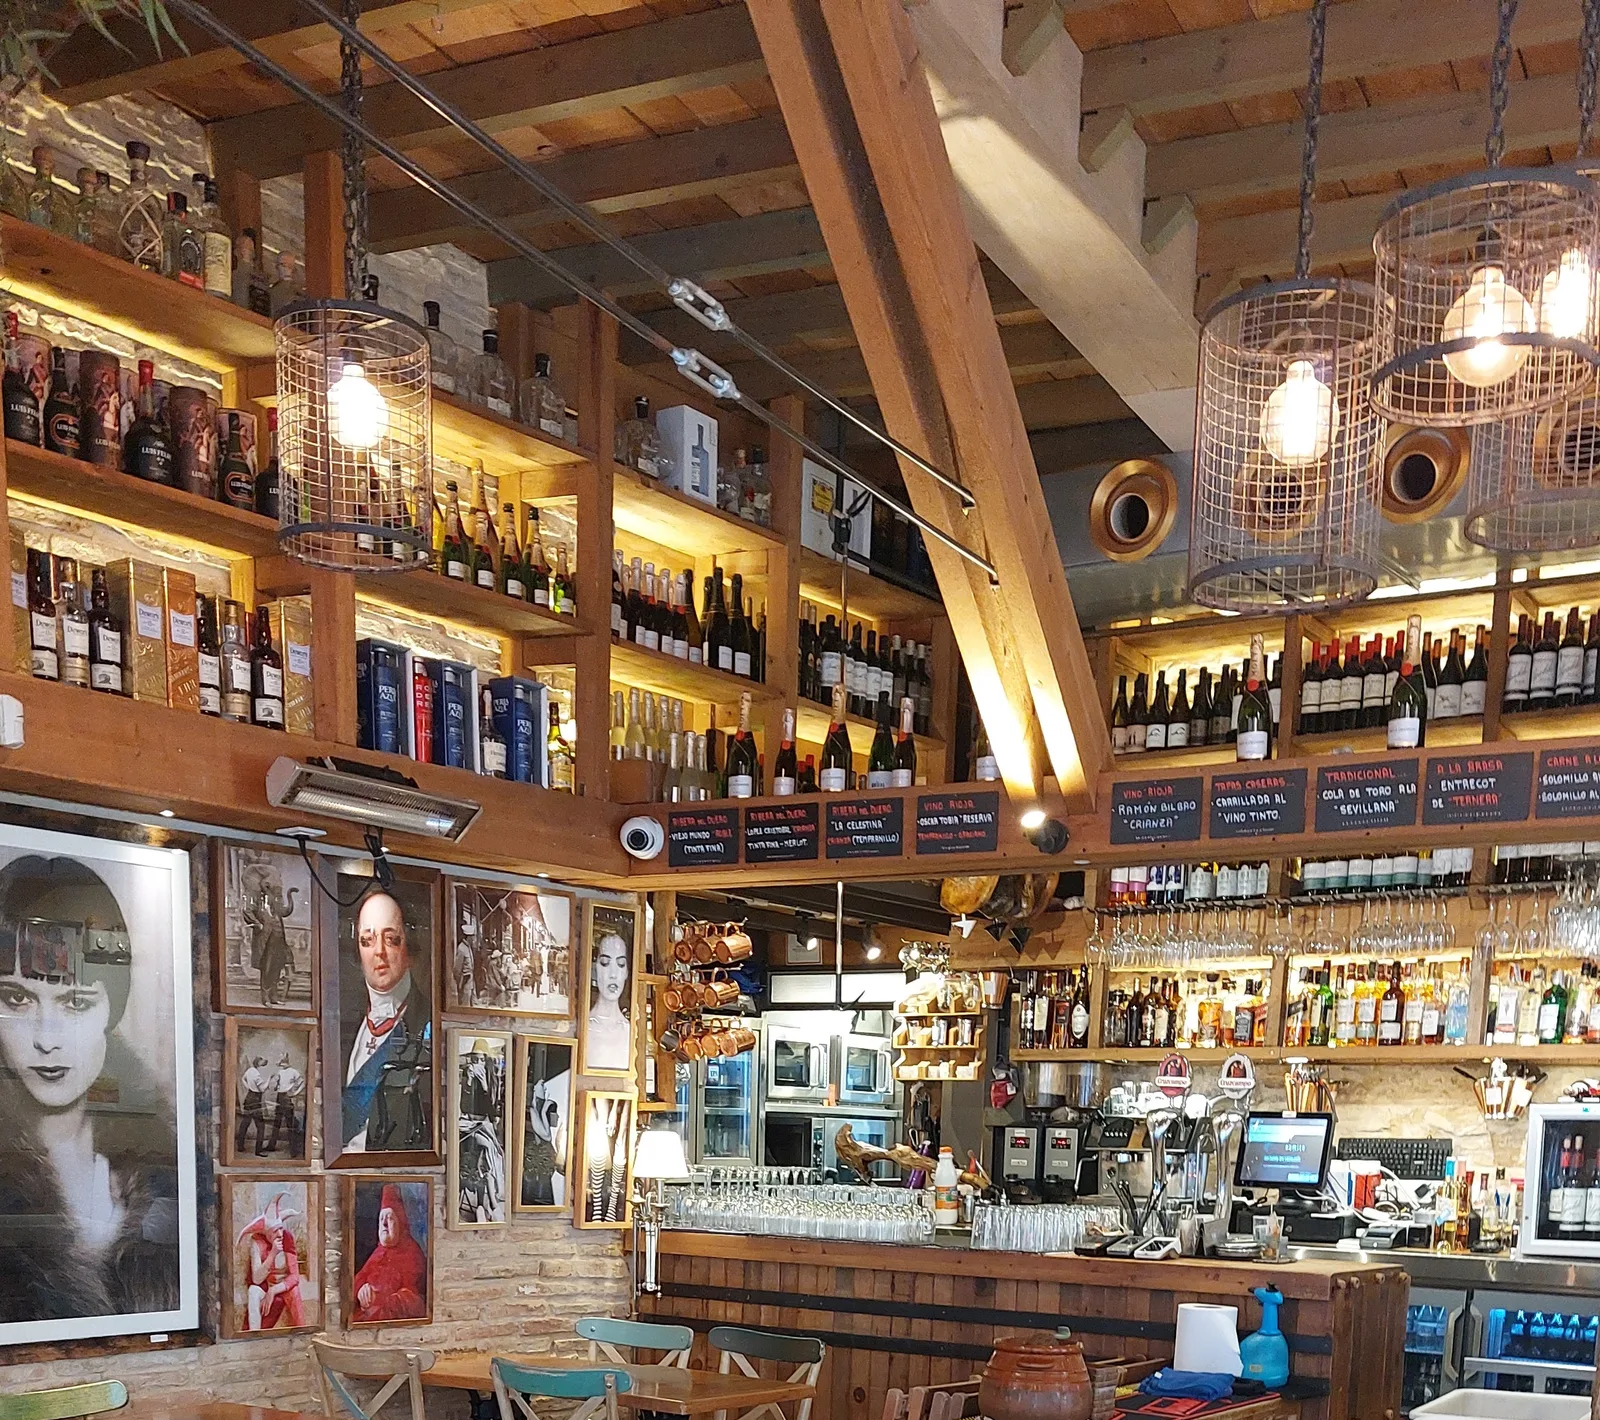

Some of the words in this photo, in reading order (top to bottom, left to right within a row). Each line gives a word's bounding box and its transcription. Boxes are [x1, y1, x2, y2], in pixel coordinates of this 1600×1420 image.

[1547, 755, 1579, 767] CARNE
[1585, 753, 1591, 764] A
[1437, 763, 1444, 775] A
[1449, 762, 1461, 774] LA
[1467, 759, 1504, 773] BRASA
[1215, 780, 1242, 792] TAPAS
[1441, 777, 1497, 792] ENTRECOT
[1123, 788, 1143, 799] VINO
[1322, 788, 1345, 801] COLA
[1349, 788, 1360, 799] DE
[1365, 785, 1392, 797] TORO
[1160, 800, 1197, 812] BILBAO
[1216, 793, 1271, 808] CARRILLADA
[1275, 793, 1287, 804] AL
[1432, 797, 1444, 809] DE
[832, 805, 857, 817] RIBERA
[924, 802, 944, 812] VINO
[919, 817, 939, 826] OSCAR
[852, 831, 900, 846] (TEMPRANILLO)
[1220, 1079, 1252, 1088] Cruzcampo
